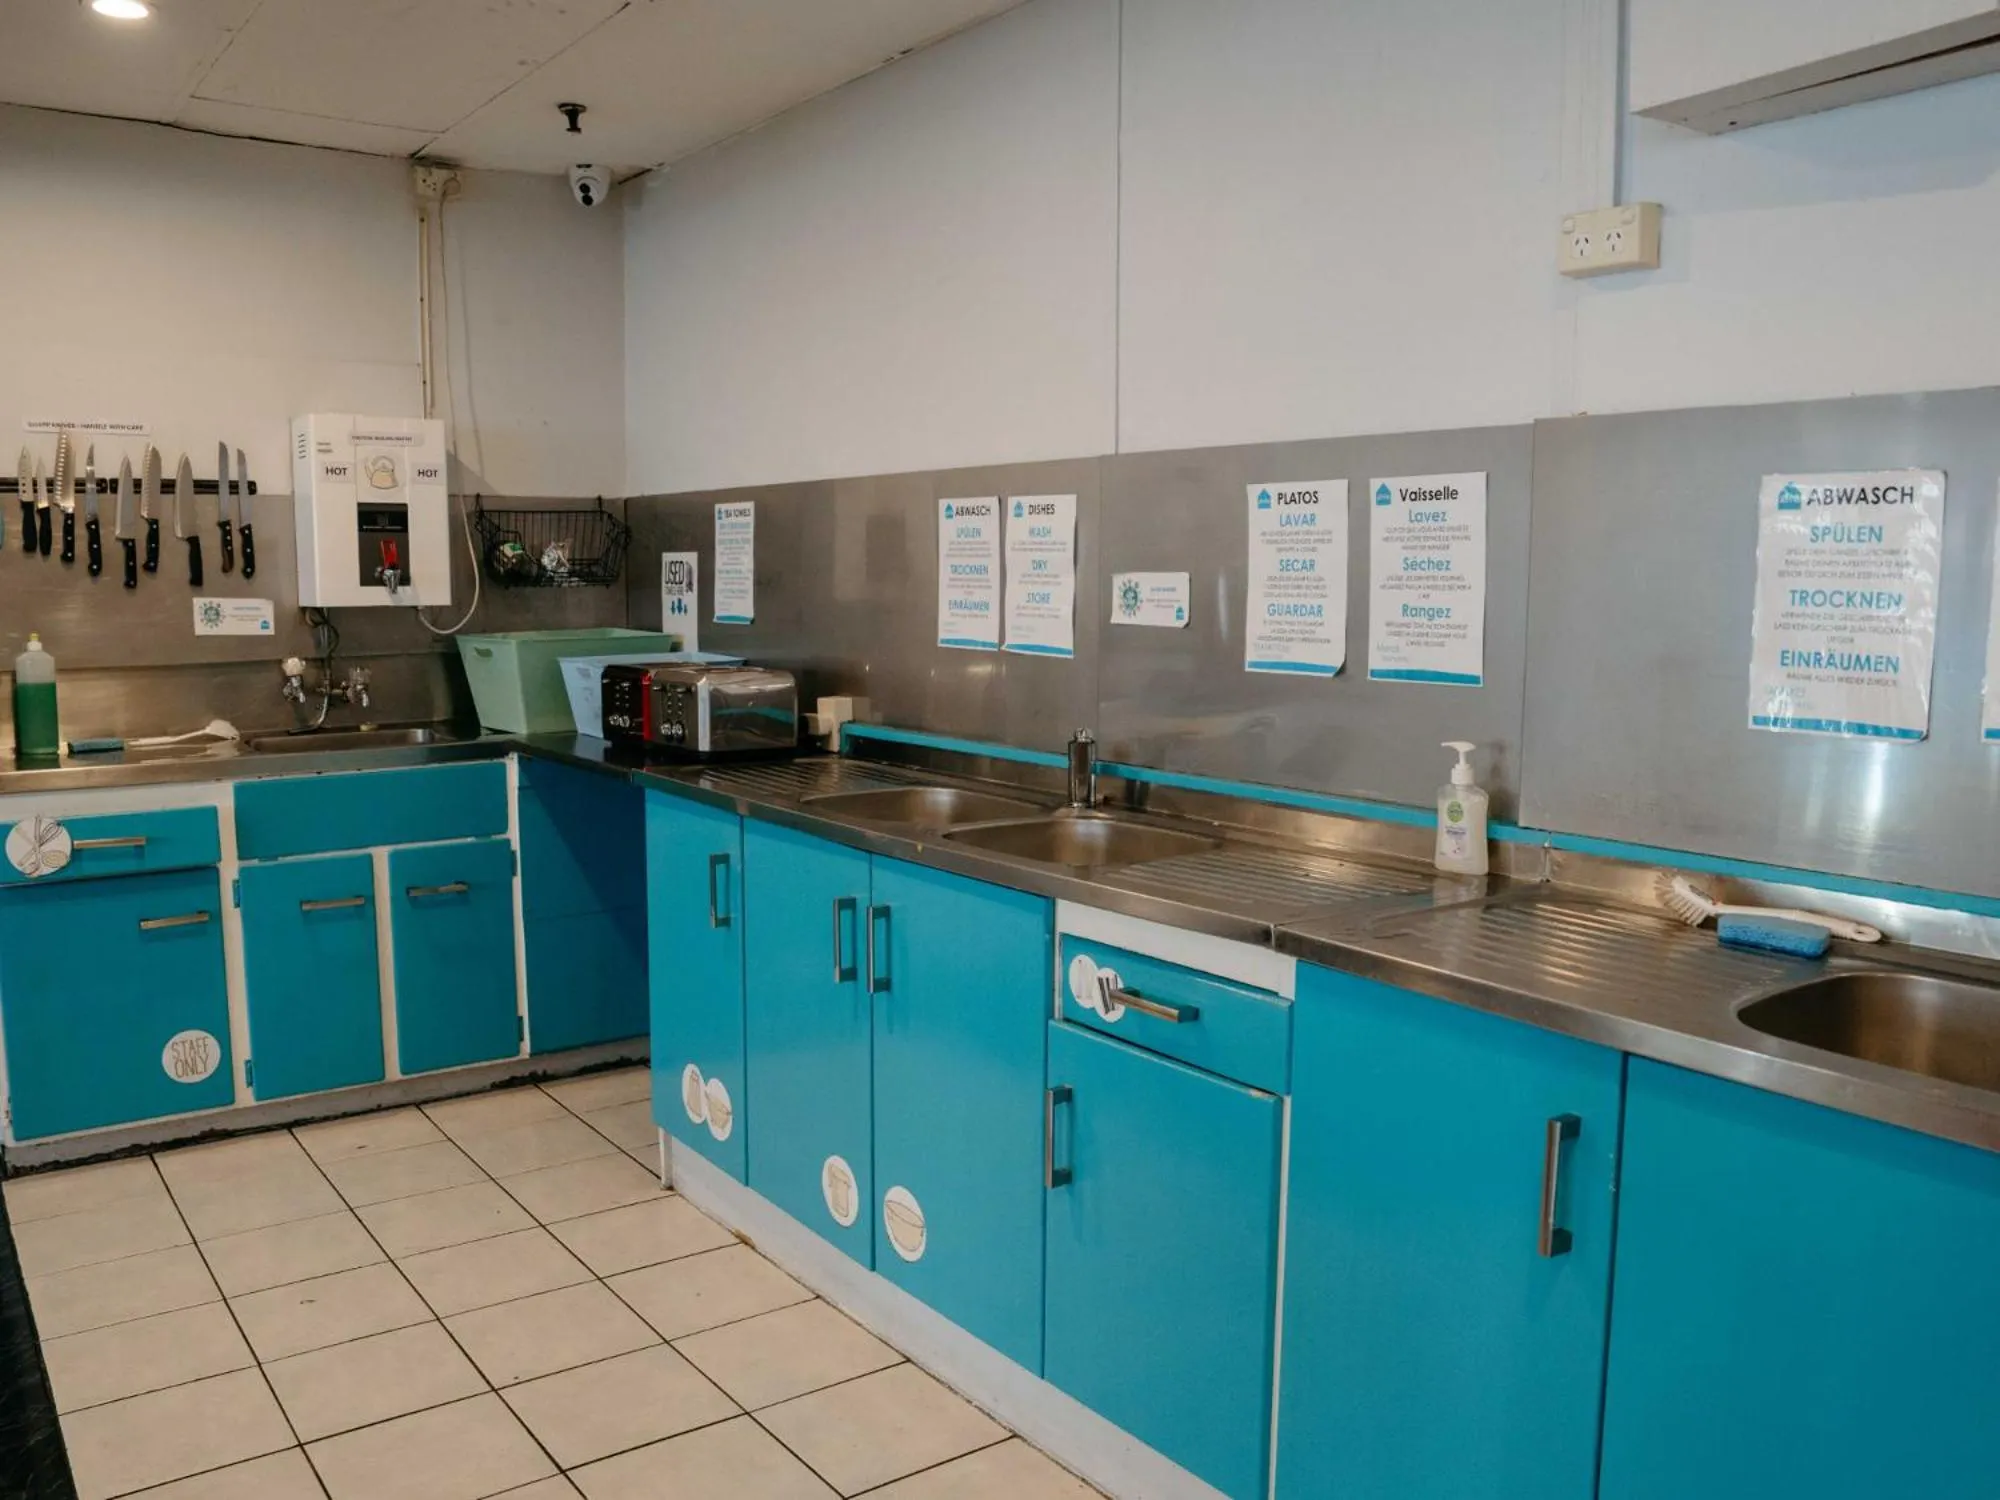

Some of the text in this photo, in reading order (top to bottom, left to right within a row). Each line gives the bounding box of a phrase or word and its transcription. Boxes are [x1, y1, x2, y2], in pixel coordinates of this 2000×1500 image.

[325, 466, 348, 476] HOT
[417, 469, 438, 478] HOT
[1277, 491, 1319, 505] PLATOS
[1399, 485, 1459, 502] Vaisselle
[1806, 486, 1914, 506] ABWASCH
[1028, 504, 1055, 515] DISHES
[1408, 508, 1448, 523] Lavez
[1279, 513, 1317, 527] LAVAR
[1810, 522, 1884, 544] SPÜLEN
[1279, 559, 1316, 572] SECAR
[1402, 556, 1452, 571] Séchez
[664, 560, 685, 585] USED
[1026, 592, 1052, 605] STORE
[1789, 589, 1904, 610] TROCKNEN
[1267, 603, 1323, 617] GUARDAR
[1402, 603, 1452, 621] Rangez
[1779, 648, 1901, 675] EINRÄUMEN
[171, 1036, 209, 1060] STAFF
[174, 1054, 209, 1078] ONLY
